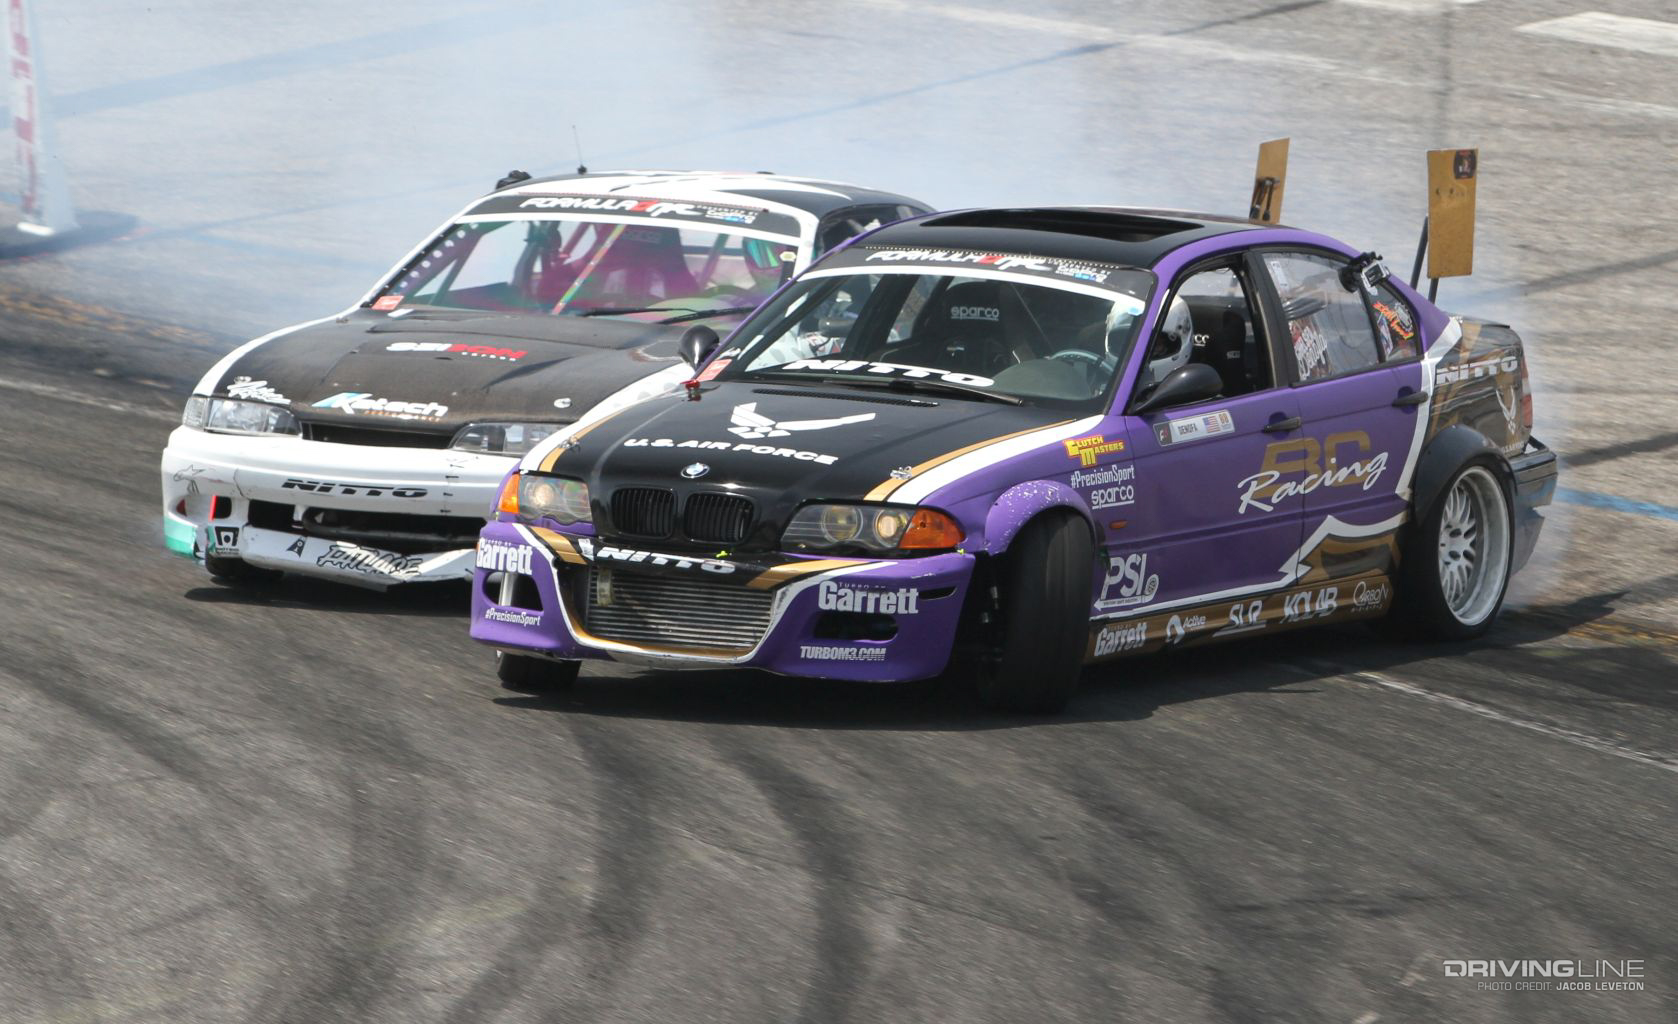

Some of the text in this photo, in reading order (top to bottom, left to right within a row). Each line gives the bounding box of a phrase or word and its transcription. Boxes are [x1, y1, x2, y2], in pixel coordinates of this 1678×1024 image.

[950, 306, 1000, 321] sparco
[782, 359, 994, 387] NITTO
[1436, 356, 1518, 385] NITTO
[677, 440, 731, 450] AIR
[733, 444, 838, 465] FORCE
[282, 479, 428, 498] NITTO
[1071, 464, 1135, 489] #PrecisionSport
[1237, 452, 1388, 514] Racing
[1091, 485, 1135, 509] sparco
[476, 537, 532, 576] Garrett
[596, 547, 736, 574] NITTO
[818, 580, 919, 615] Garrett
[484, 607, 541, 628] #PrecisionSport
[1094, 621, 1148, 657] Garrett
[800, 646, 887, 661] TURBOM3.COM
